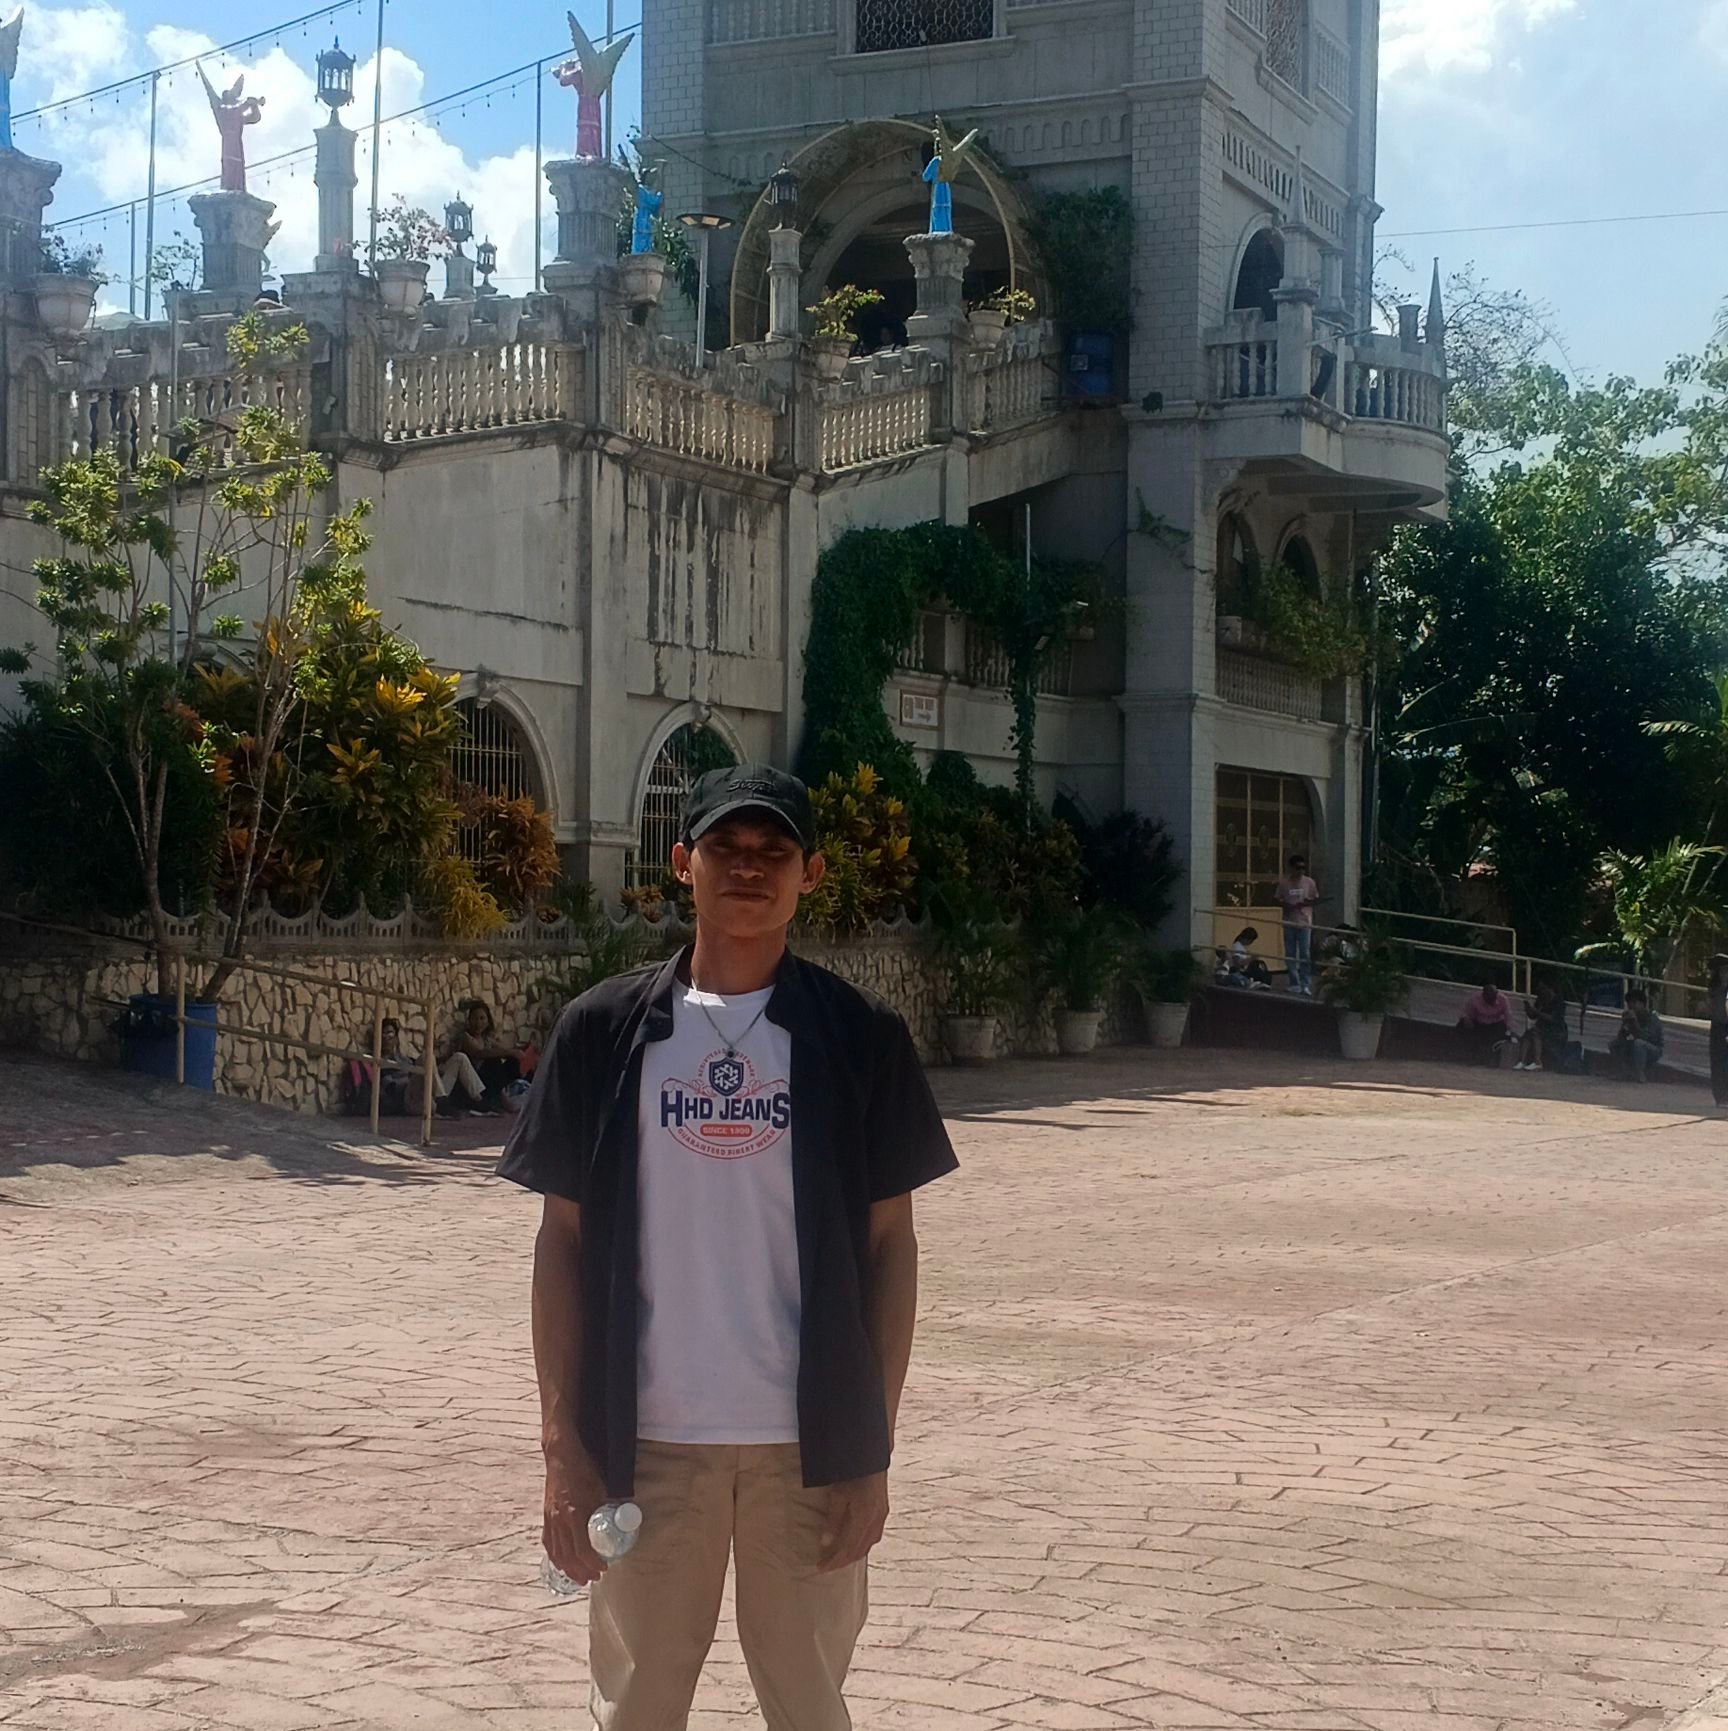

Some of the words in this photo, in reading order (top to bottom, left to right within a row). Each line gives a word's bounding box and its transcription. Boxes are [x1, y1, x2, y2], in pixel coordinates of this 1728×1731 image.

[660, 1090, 713, 1127] HHD
[719, 1092, 791, 1129] JEANS
[677, 1128, 726, 1156] GUARANTEED
[702, 1126, 728, 1135] SINCE
